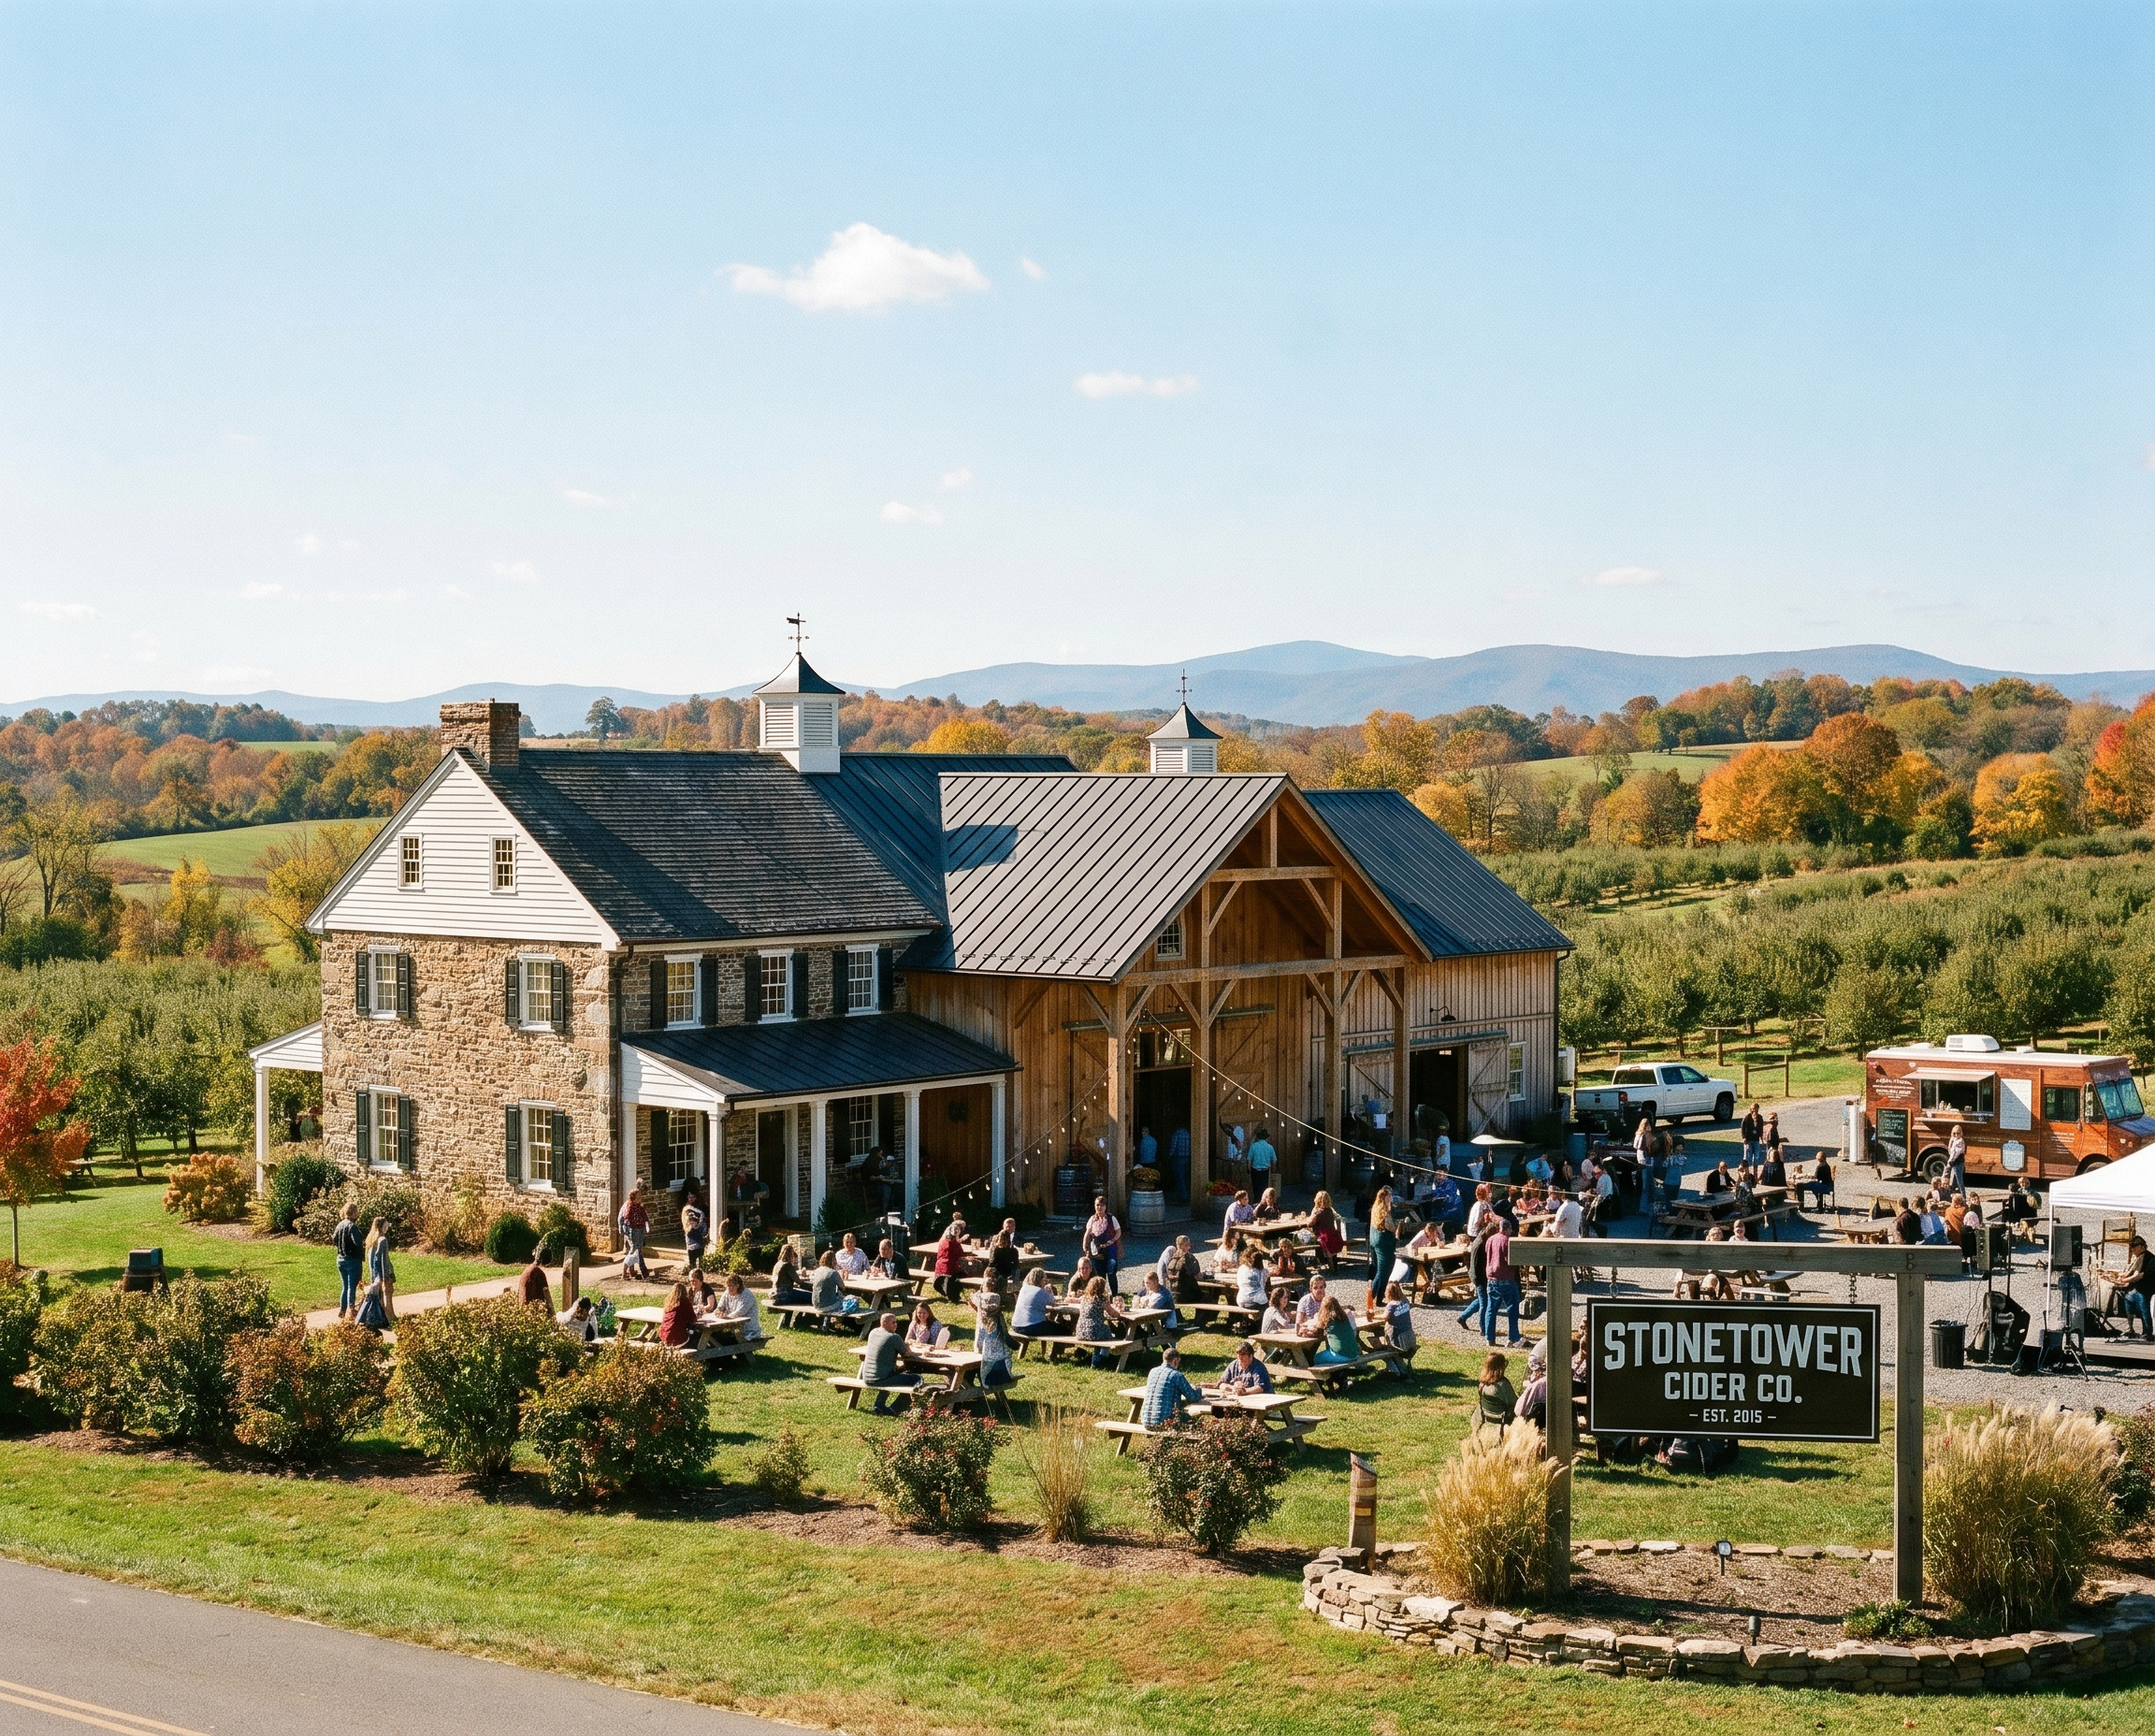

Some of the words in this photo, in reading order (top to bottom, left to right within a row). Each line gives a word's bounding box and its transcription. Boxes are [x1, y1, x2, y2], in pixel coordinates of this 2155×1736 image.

[1604, 1322, 1862, 1378] STONETOWER
[1664, 1371, 1746, 1401] CIDER
[1757, 1373, 1802, 1404] CO.
[1702, 1409, 1728, 1423] EST.
[1733, 1410, 1762, 1424] 2015
